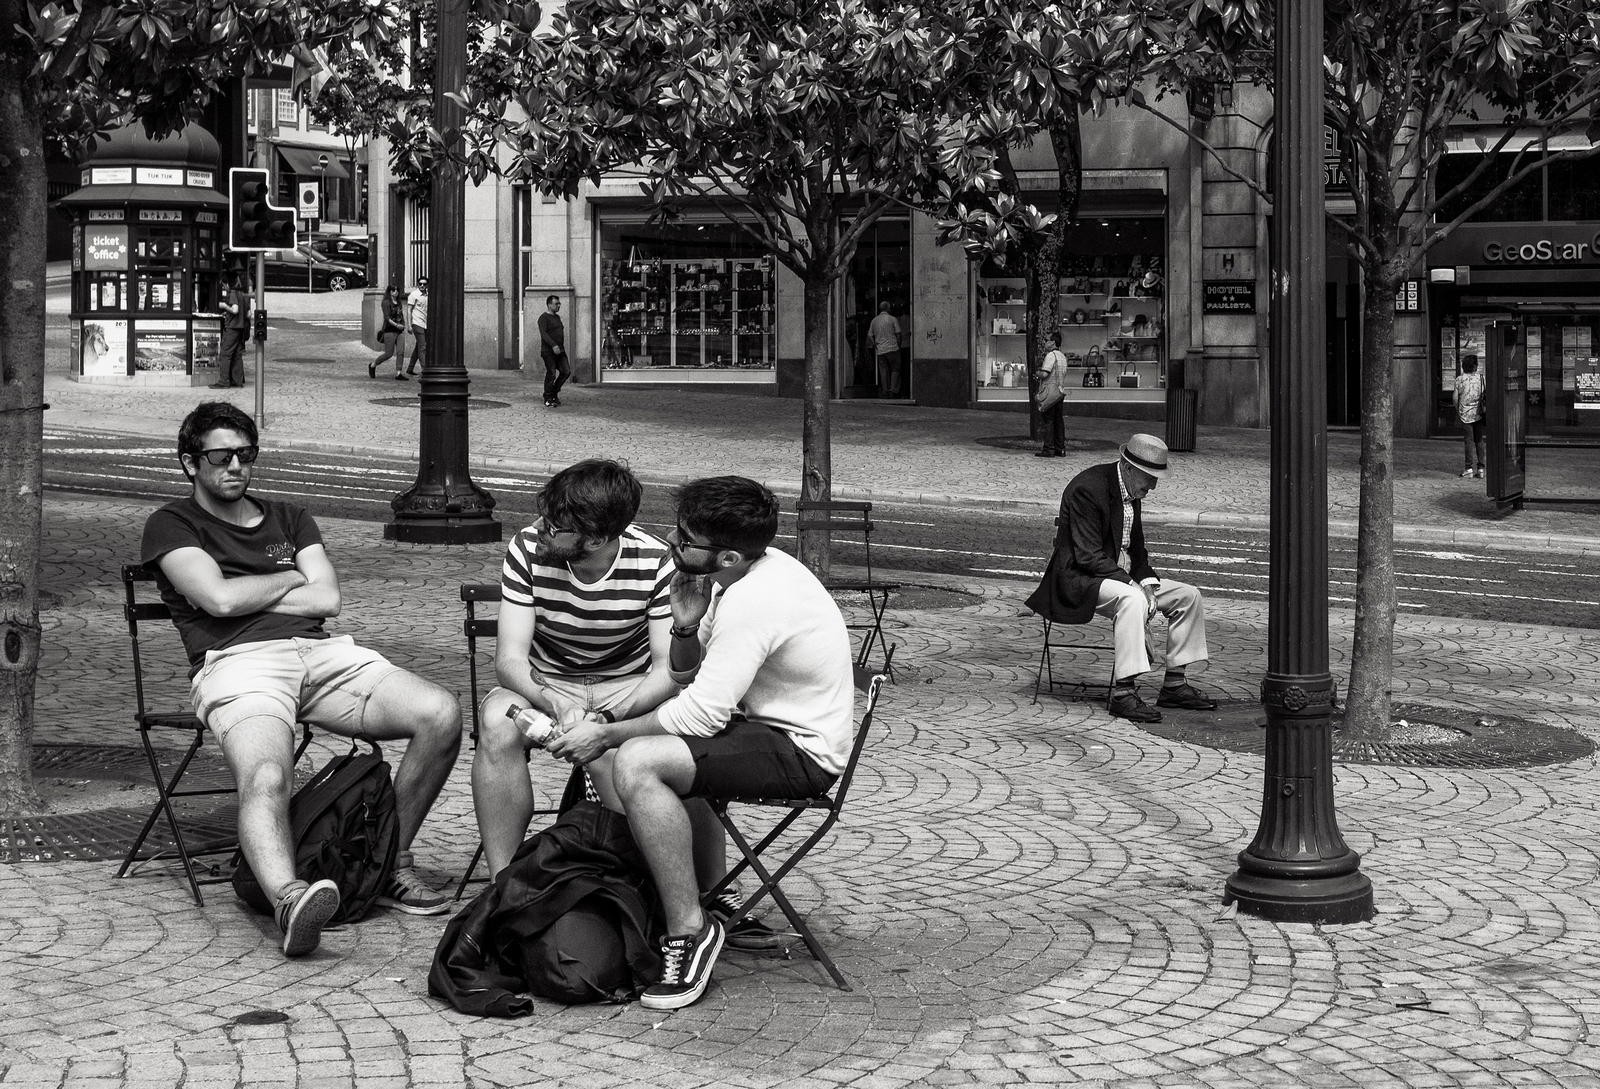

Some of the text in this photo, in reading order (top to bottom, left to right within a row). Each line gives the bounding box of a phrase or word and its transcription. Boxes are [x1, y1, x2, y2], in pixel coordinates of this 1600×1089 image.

[93, 236, 119, 246] ticket
[94, 249, 119, 259] office
[1483, 240, 1588, 261] GeoStar
[1207, 286, 1251, 294] HOTEL
